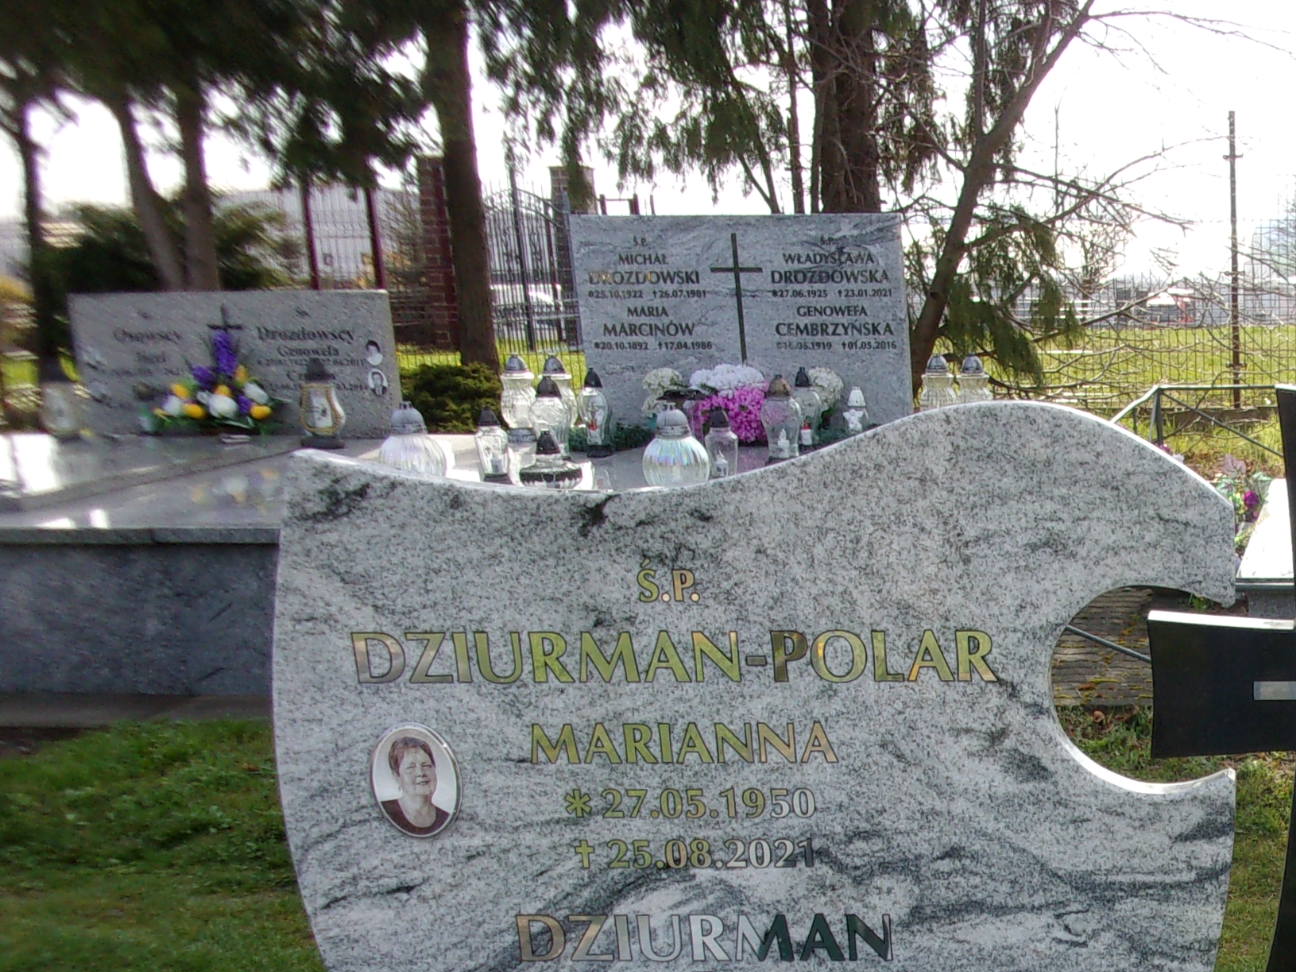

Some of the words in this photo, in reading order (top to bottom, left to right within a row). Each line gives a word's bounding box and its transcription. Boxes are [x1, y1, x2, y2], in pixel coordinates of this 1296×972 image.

[618, 253, 669, 265] MICHAŁ
[782, 252, 875, 265] WŁADYSŁAWA
[627, 306, 669, 317] MARIA
[796, 305, 868, 317] GENOWEFA
[603, 320, 695, 337] MARCINÓW
[775, 319, 894, 337] CEMBRZYŃSKA
[637, 558, 699, 602] Ś.P.
[351, 629, 999, 684] DZIURMAN-POLAR
[530, 722, 838, 765] MARIANNA
[515, 912, 894, 963] DZIURMAN
